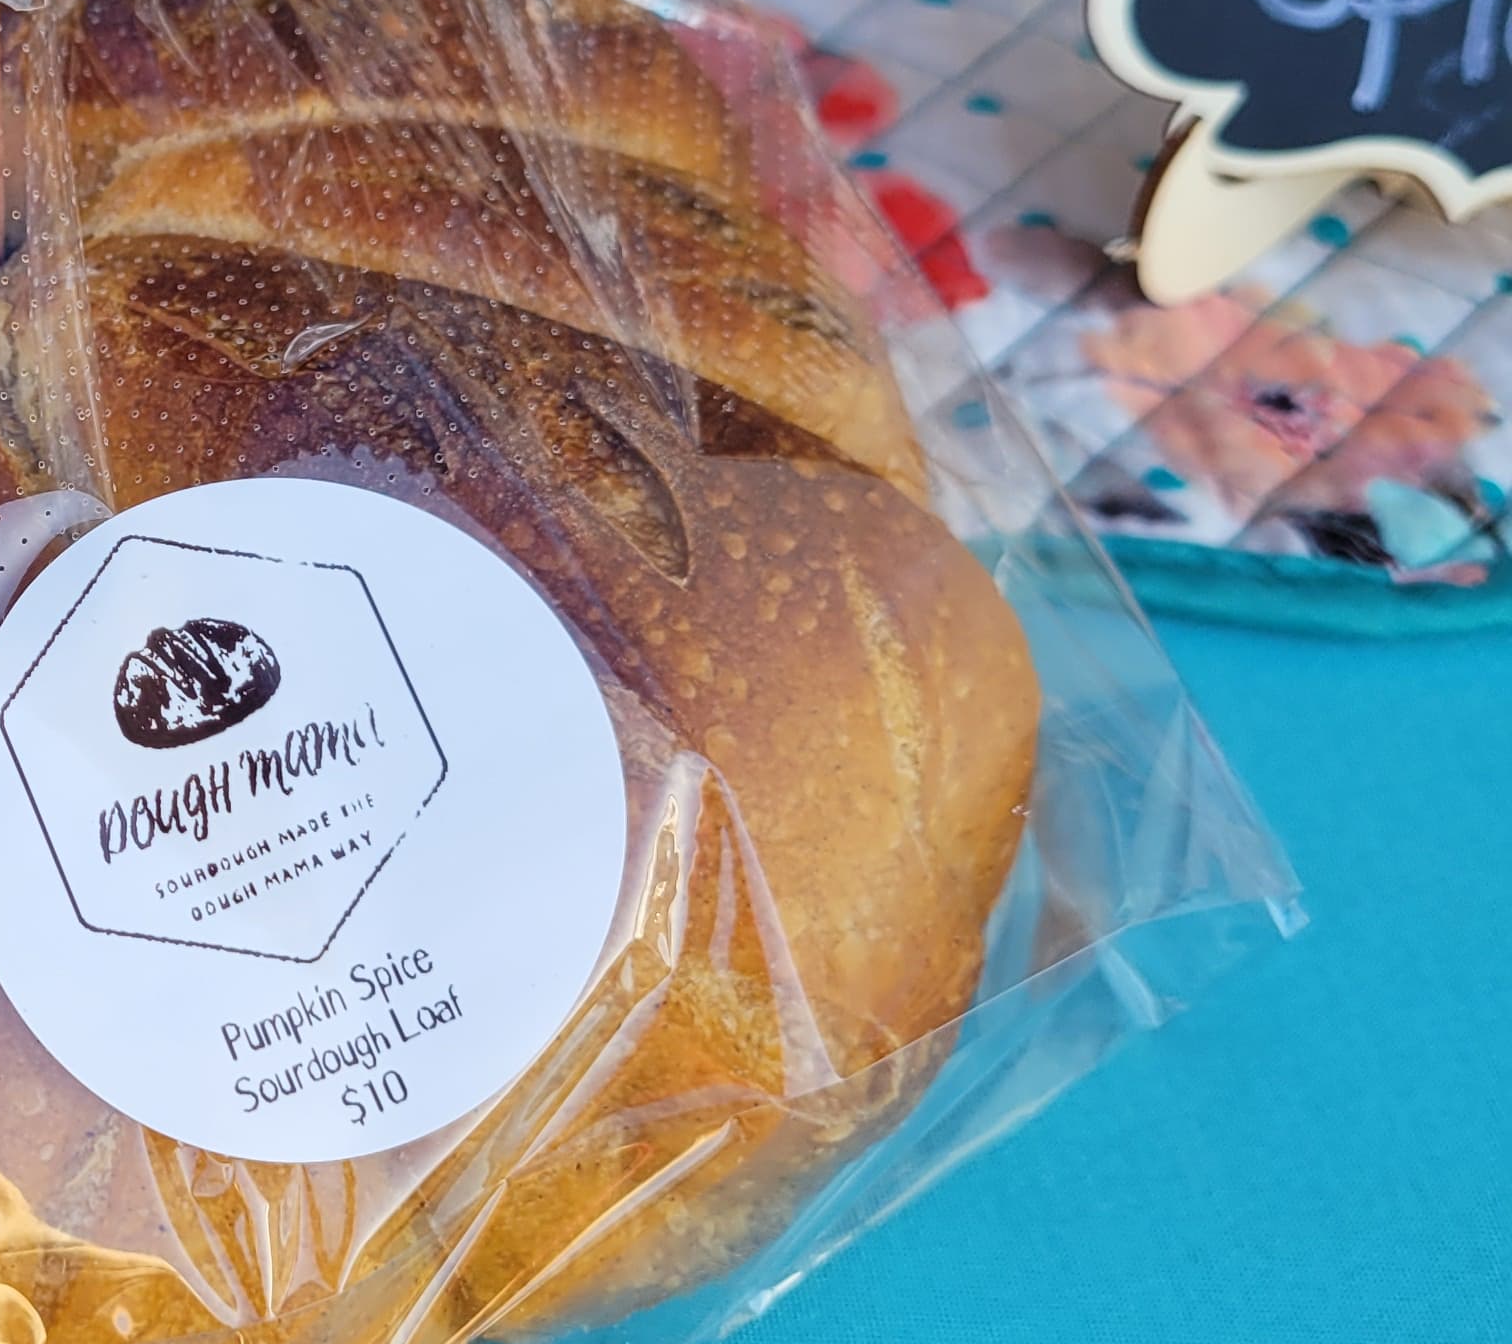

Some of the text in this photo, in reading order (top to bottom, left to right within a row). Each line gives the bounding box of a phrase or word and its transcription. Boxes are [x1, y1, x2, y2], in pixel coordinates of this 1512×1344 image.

[155, 840, 271, 899] SOURDOUGH
[278, 811, 331, 846] MADE
[191, 829, 373, 922] DOUGH MAMA WAY
[221, 948, 434, 1061] Pumpkin Spice
[234, 983, 464, 1113] Sourdough Loaf
[341, 1069, 409, 1126] $10
